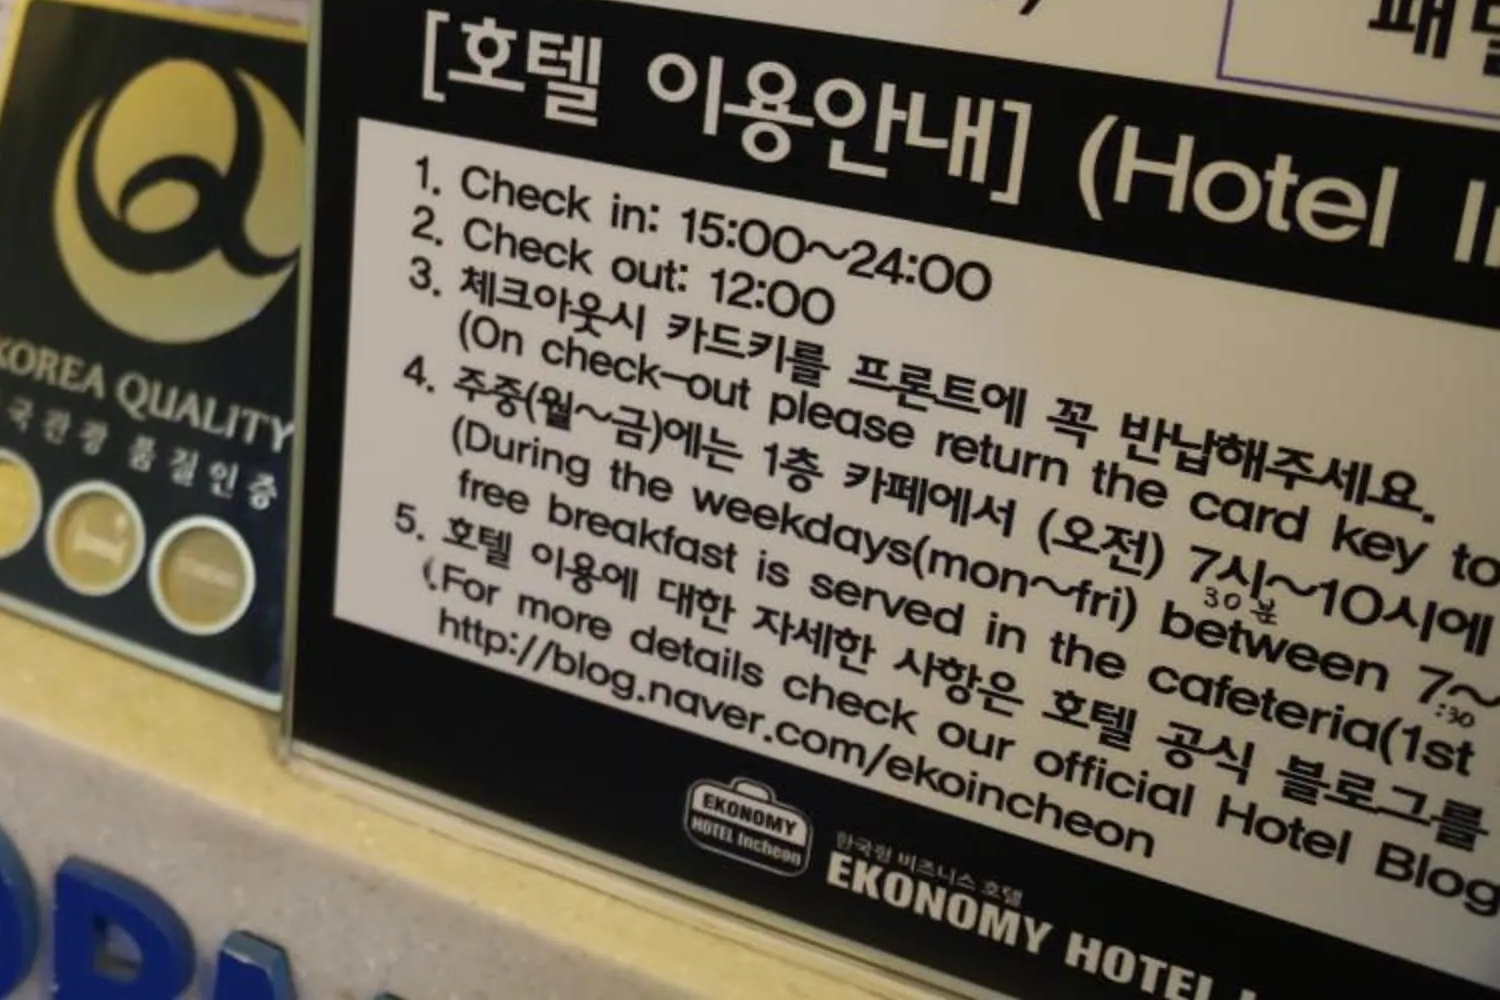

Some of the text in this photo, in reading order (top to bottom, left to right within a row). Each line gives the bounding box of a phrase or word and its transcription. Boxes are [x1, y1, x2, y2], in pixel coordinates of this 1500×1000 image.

[411, 206, 836, 326] 2. Check out: 12:00
[415, 155, 993, 302] 1. Check in: 15:00~24:00
[422, 9, 1500, 269] [호텔 이용안내] (Hotel I
[115, 371, 296, 453] QUALITY
[403, 355, 1494, 657] 4. 주중(월~금)에는 1층 카페에서 (오전) 7시~10시에
[409, 256, 1436, 525] 3. 체크아웃시 카드키를 프론트에 꼭 반납해주세요.
[458, 309, 1500, 590] (On check-out please return the card key to
[395, 501, 1489, 852] 5. 호텔 이용에 대한 자세한 사항은 호텔 공식 블로그를
[451, 414, 591, 488] (During
[610, 460, 674, 504] the
[691, 482, 1138, 633] weekdays(mon~fri)
[1160, 600, 1390, 693] between
[457, 469, 1476, 778] free breakfast is served in the cafeteria(1st
[422, 555, 1500, 917] (For more details check our official Hotel Blog
[437, 608, 1157, 859] http://blog.naver.com/ekoincheon
[691, 816, 801, 867] HOTEL Incheon
[703, 793, 797, 836] EKONOMY
[826, 851, 1213, 1000] EKONOMY HOTEL
